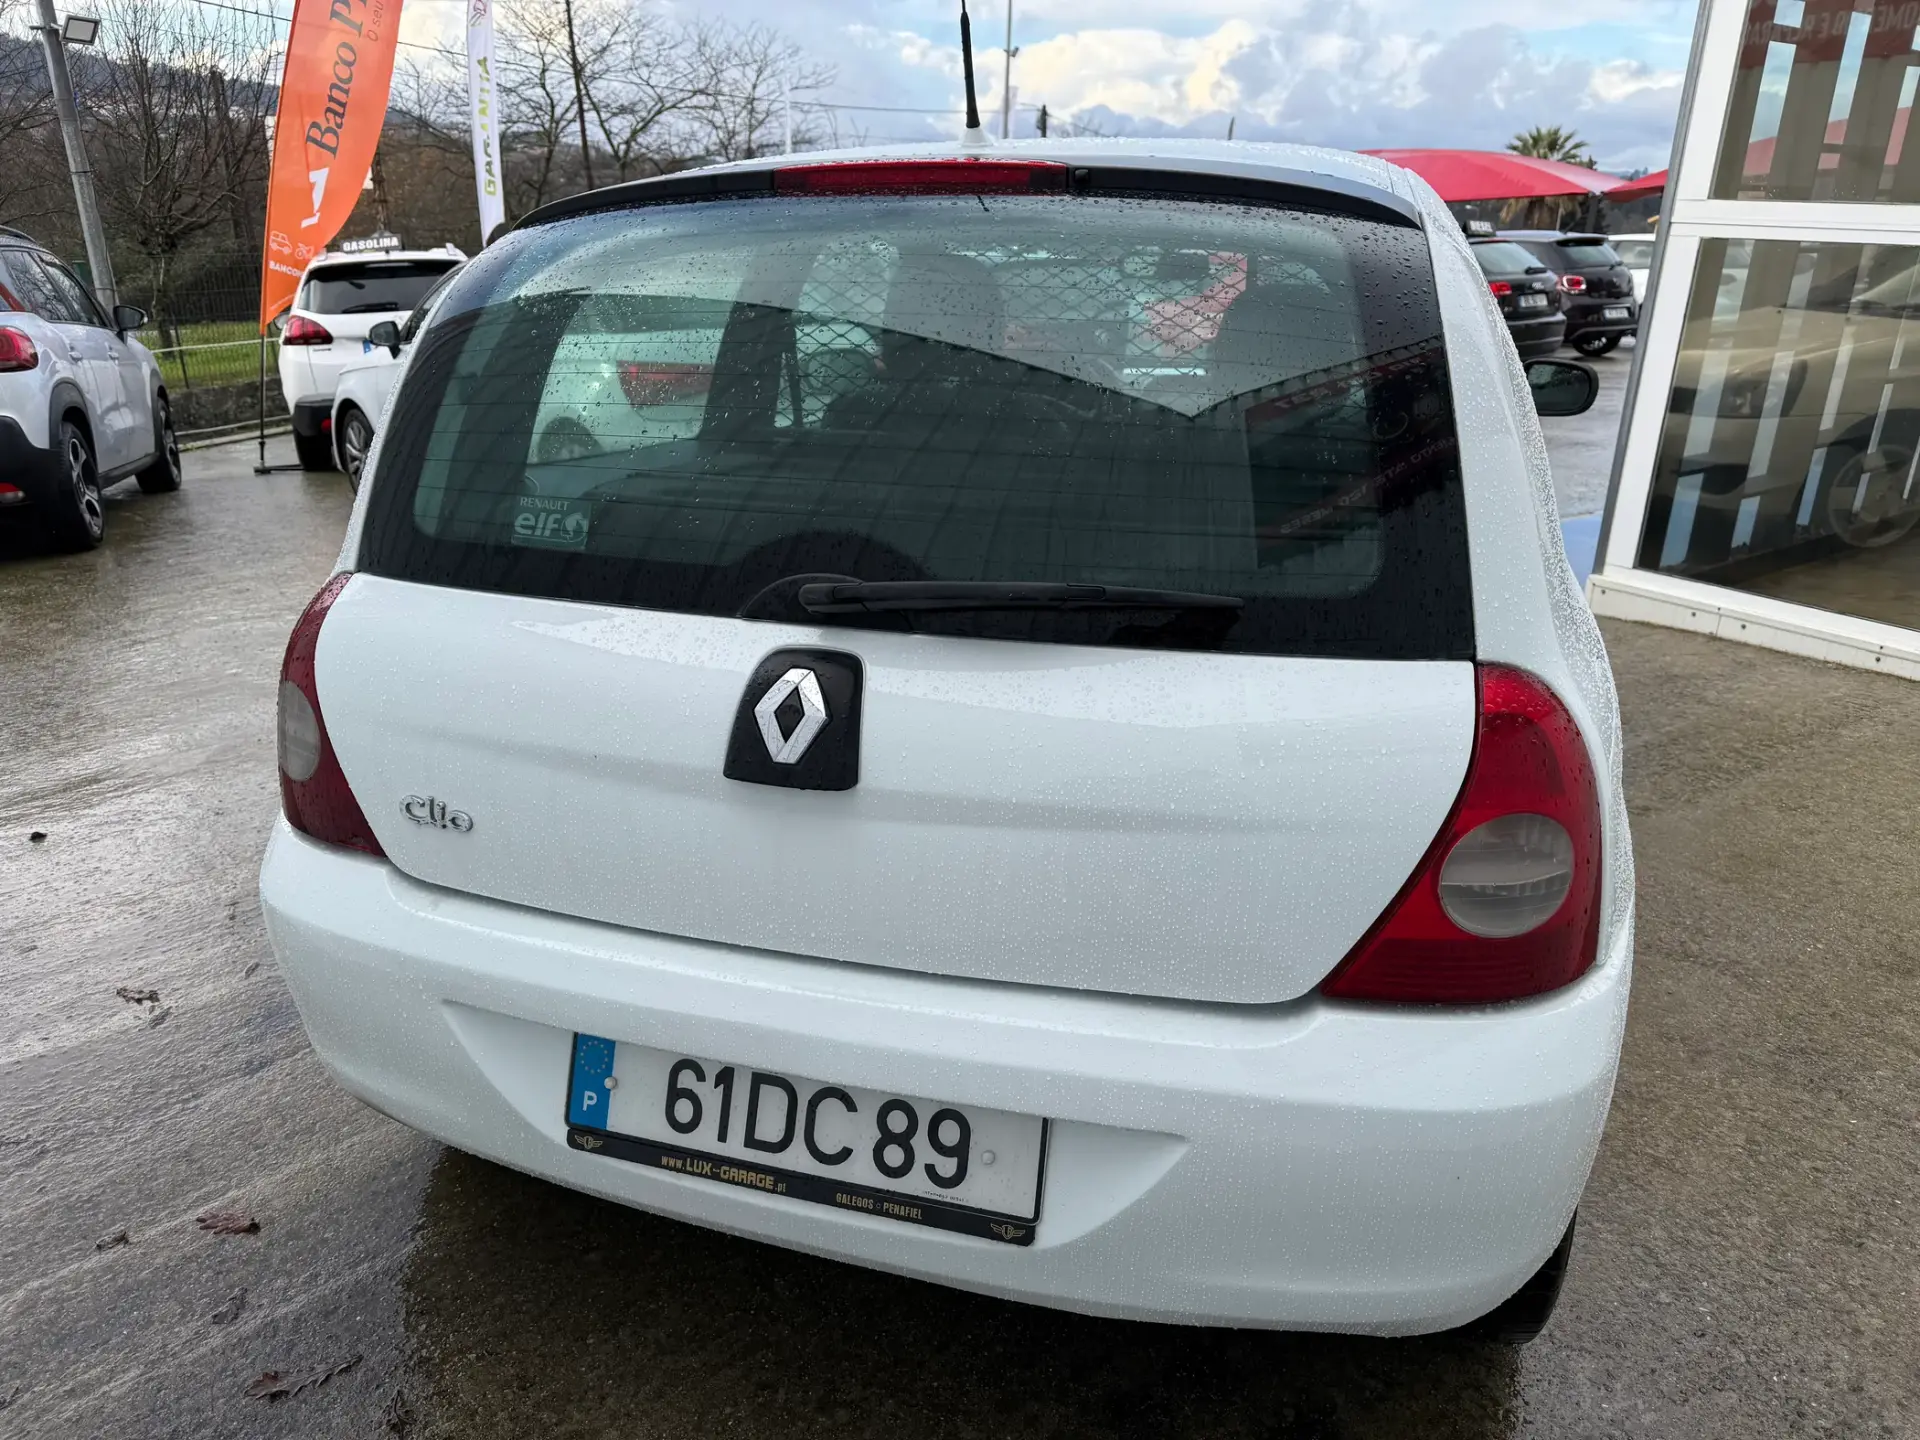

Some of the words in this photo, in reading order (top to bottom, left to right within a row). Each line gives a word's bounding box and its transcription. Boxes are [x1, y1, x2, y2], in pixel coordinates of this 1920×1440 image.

[305, 41, 357, 160] Banco
[342, 236, 399, 252] GASOLINA
[519, 496, 571, 511] RENAULT
[514, 511, 562, 537] elf
[399, 794, 474, 833] Clio
[582, 1089, 598, 1112] P
[835, 1191, 875, 1211] GALEGOS
[882, 1201, 923, 1221] PENAFIEL
